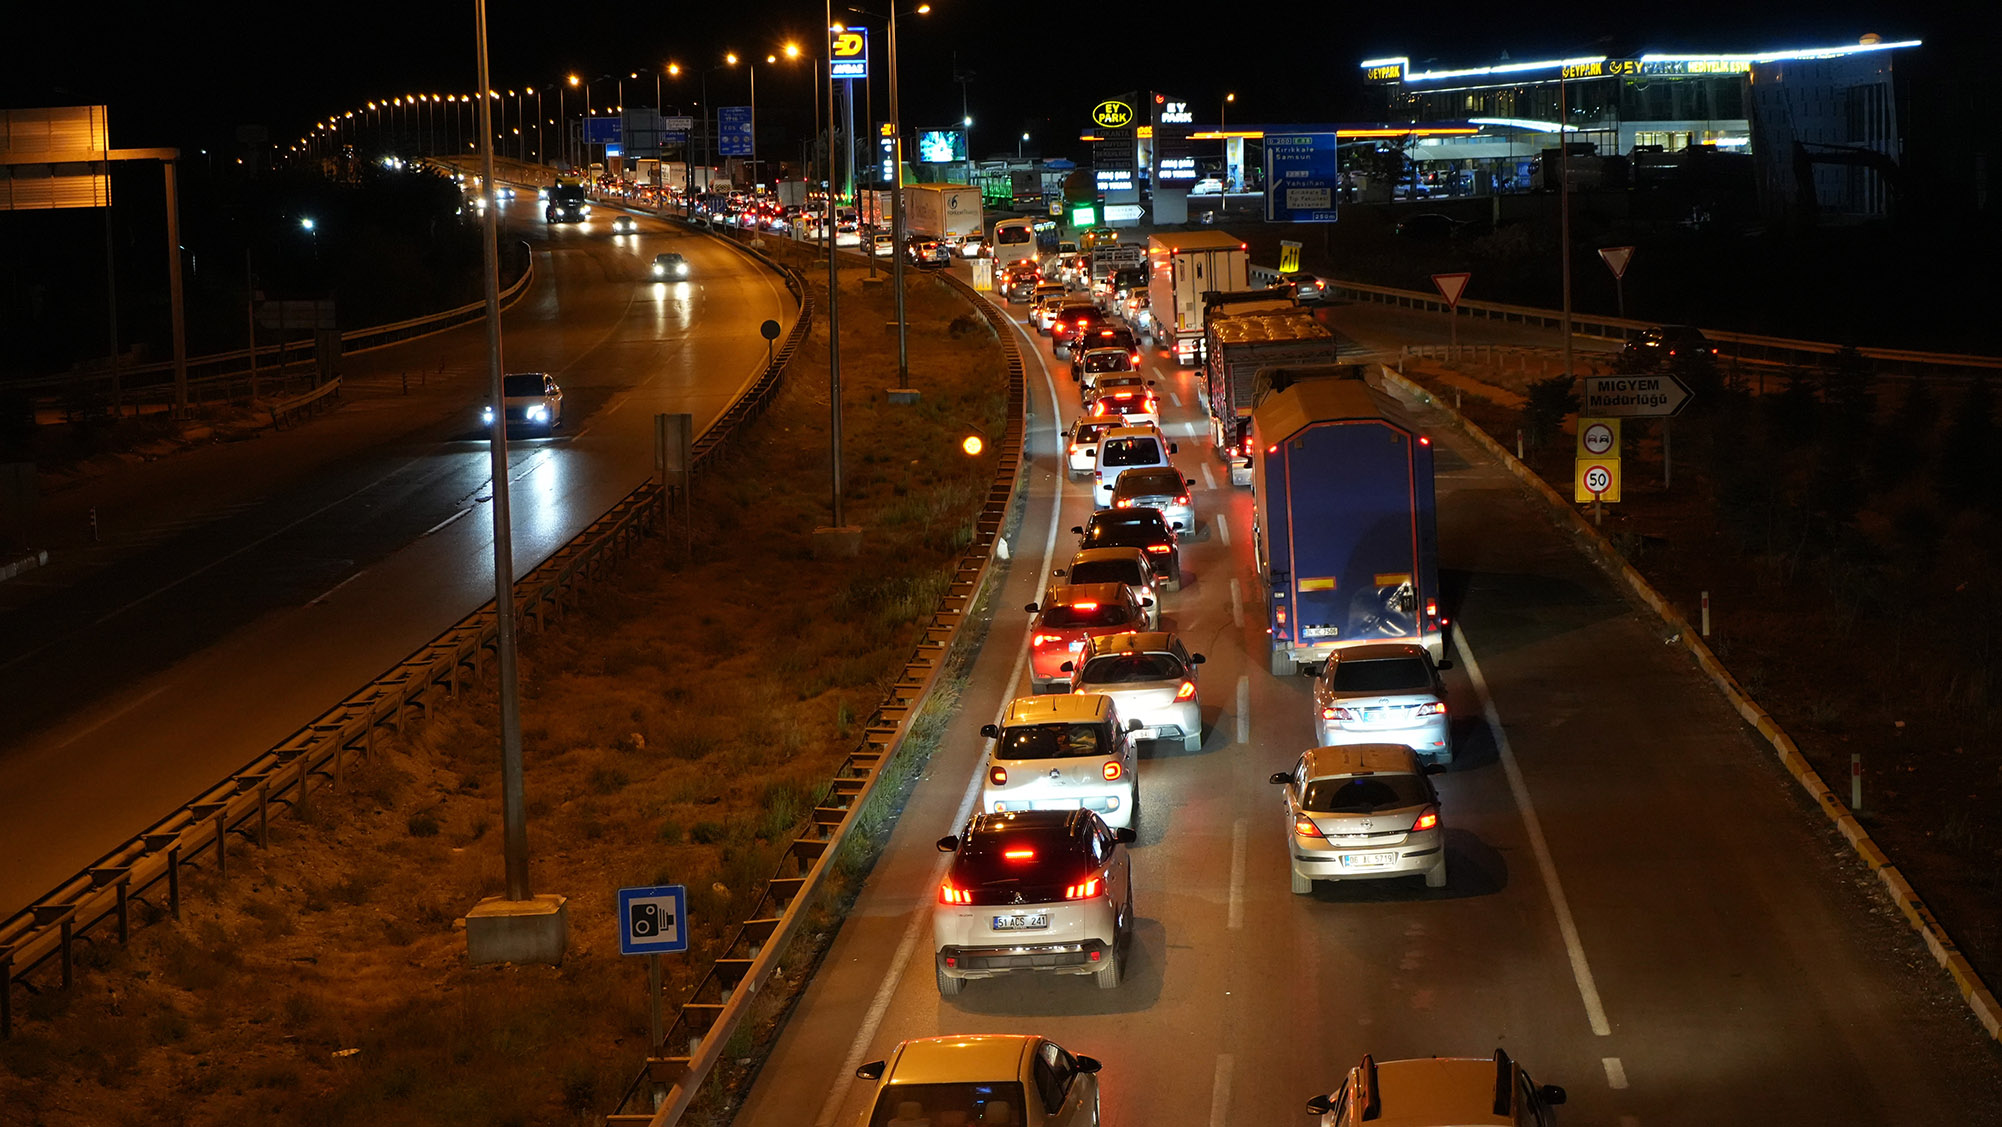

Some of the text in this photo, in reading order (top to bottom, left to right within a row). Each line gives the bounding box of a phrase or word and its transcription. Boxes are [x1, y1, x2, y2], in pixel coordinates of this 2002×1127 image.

[1373, 65, 1400, 80] EYPARK
[1569, 62, 1602, 77] EYPARK
[1105, 103, 1119, 113] EY
[1166, 102, 1187, 113] EY
[1098, 113, 1126, 122] PARK
[1161, 112, 1192, 123] PARK
[1598, 380, 1659, 391] MIGYEM
[1590, 394, 1667, 407] Müdürlüğü
[1589, 473, 1606, 486] 50
[1375, 854, 1392, 863] 5719
[998, 916, 1046, 927] 51 ACS 241
